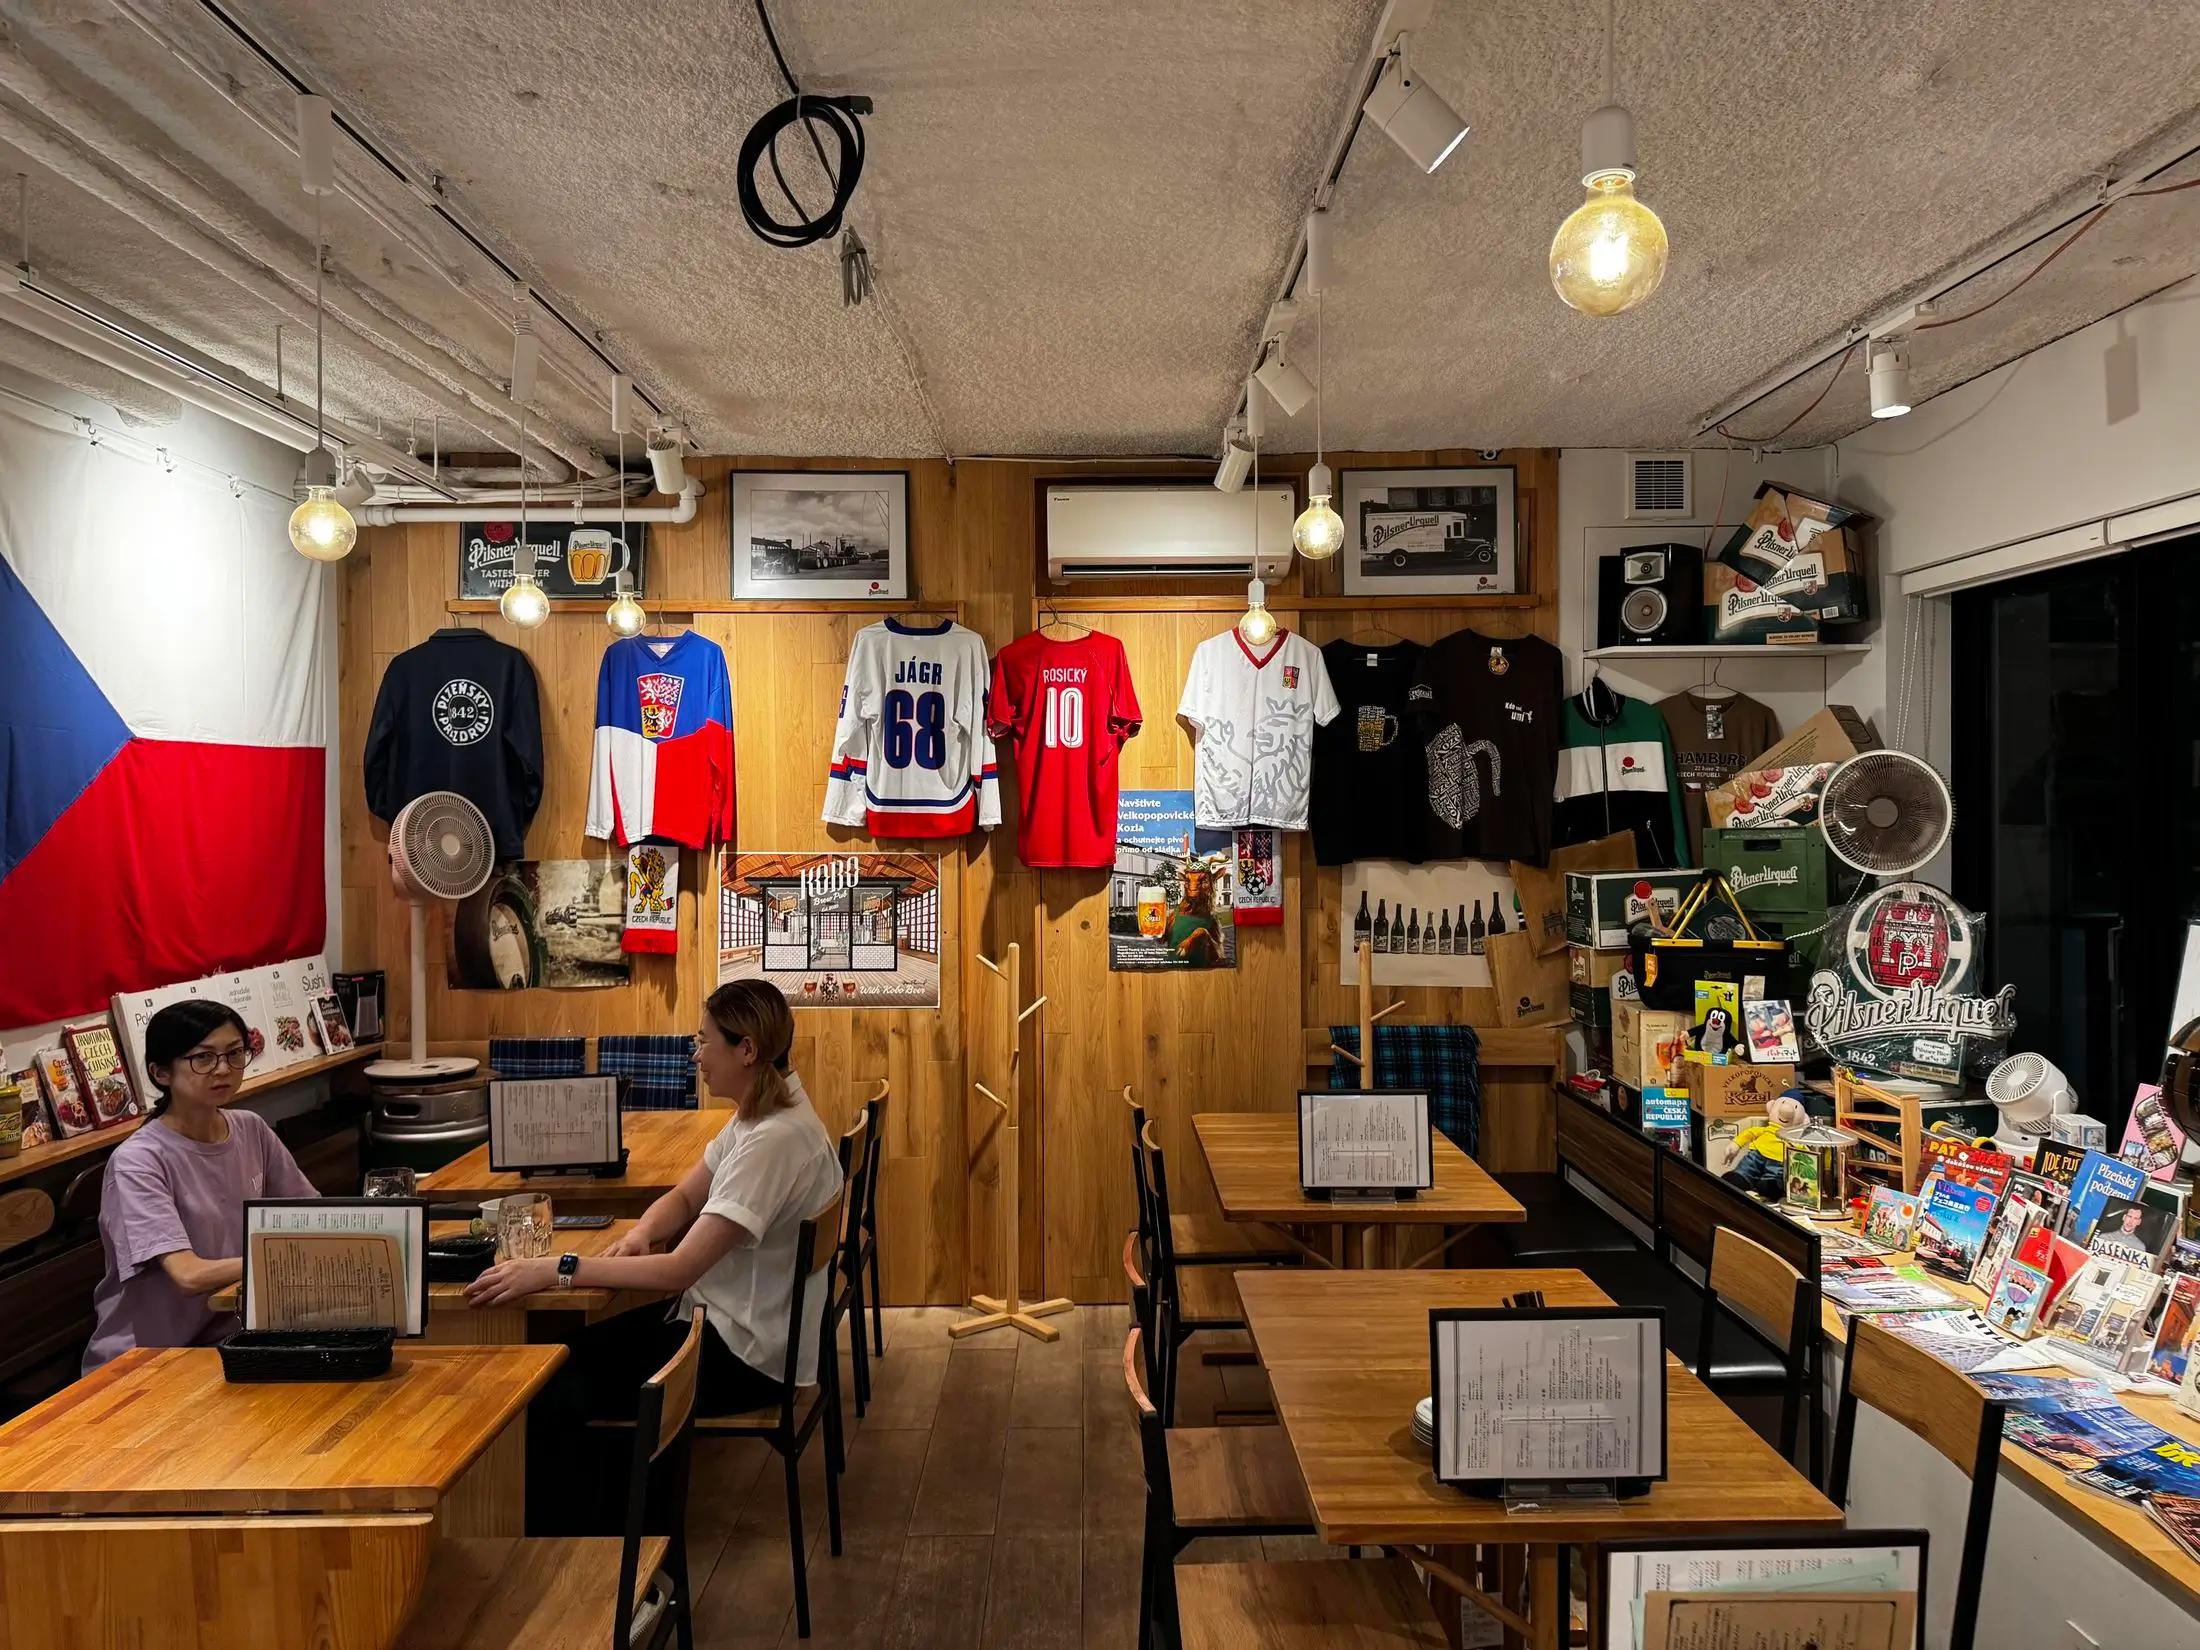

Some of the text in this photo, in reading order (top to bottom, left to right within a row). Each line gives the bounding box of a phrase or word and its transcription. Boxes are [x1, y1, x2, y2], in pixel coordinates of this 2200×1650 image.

[1373, 523, 1411, 548] Pilsner
[1409, 514, 1440, 528] Urquell
[1754, 530, 1789, 556] Pilsner
[468, 538, 516, 571] Pilsner
[1785, 564, 1818, 581] Urquell
[488, 580, 513, 588] WITH
[1728, 593, 1761, 616] Pilsner
[895, 656, 943, 685] JÁGR
[1043, 667, 1088, 684] ROSICKÝ
[1045, 687, 1084, 748] 10
[884, 689, 946, 770] 68
[1117, 823, 1144, 832] Kozla
[1142, 845, 1153, 853] od
[1168, 836, 1184, 845] pivo
[800, 856, 860, 900] KOBO
[1730, 865, 1798, 894] Pilsner Urquell
[833, 890, 848, 900] Pub
[1898, 952, 1918, 976] P
[302, 973, 326, 992] Sushi
[859, 985, 881, 995] With
[882, 985, 905, 994] Kobo
[905, 985, 926, 995] Beer
[1804, 969, 1912, 1042] Pilsner
[75, 1029, 113, 1047] TRADITIONAL
[83, 1043, 112, 1060] CZECH
[89, 1056, 119, 1073] CUISINE
[1645, 1098, 1687, 1110] automapa
[1929, 1141, 1958, 1157] PAT
[2041, 1151, 2061, 1175] KDE
[2097, 1163, 2138, 1190] Plzeňská
[1967, 1309, 2023, 1350] TITLE
